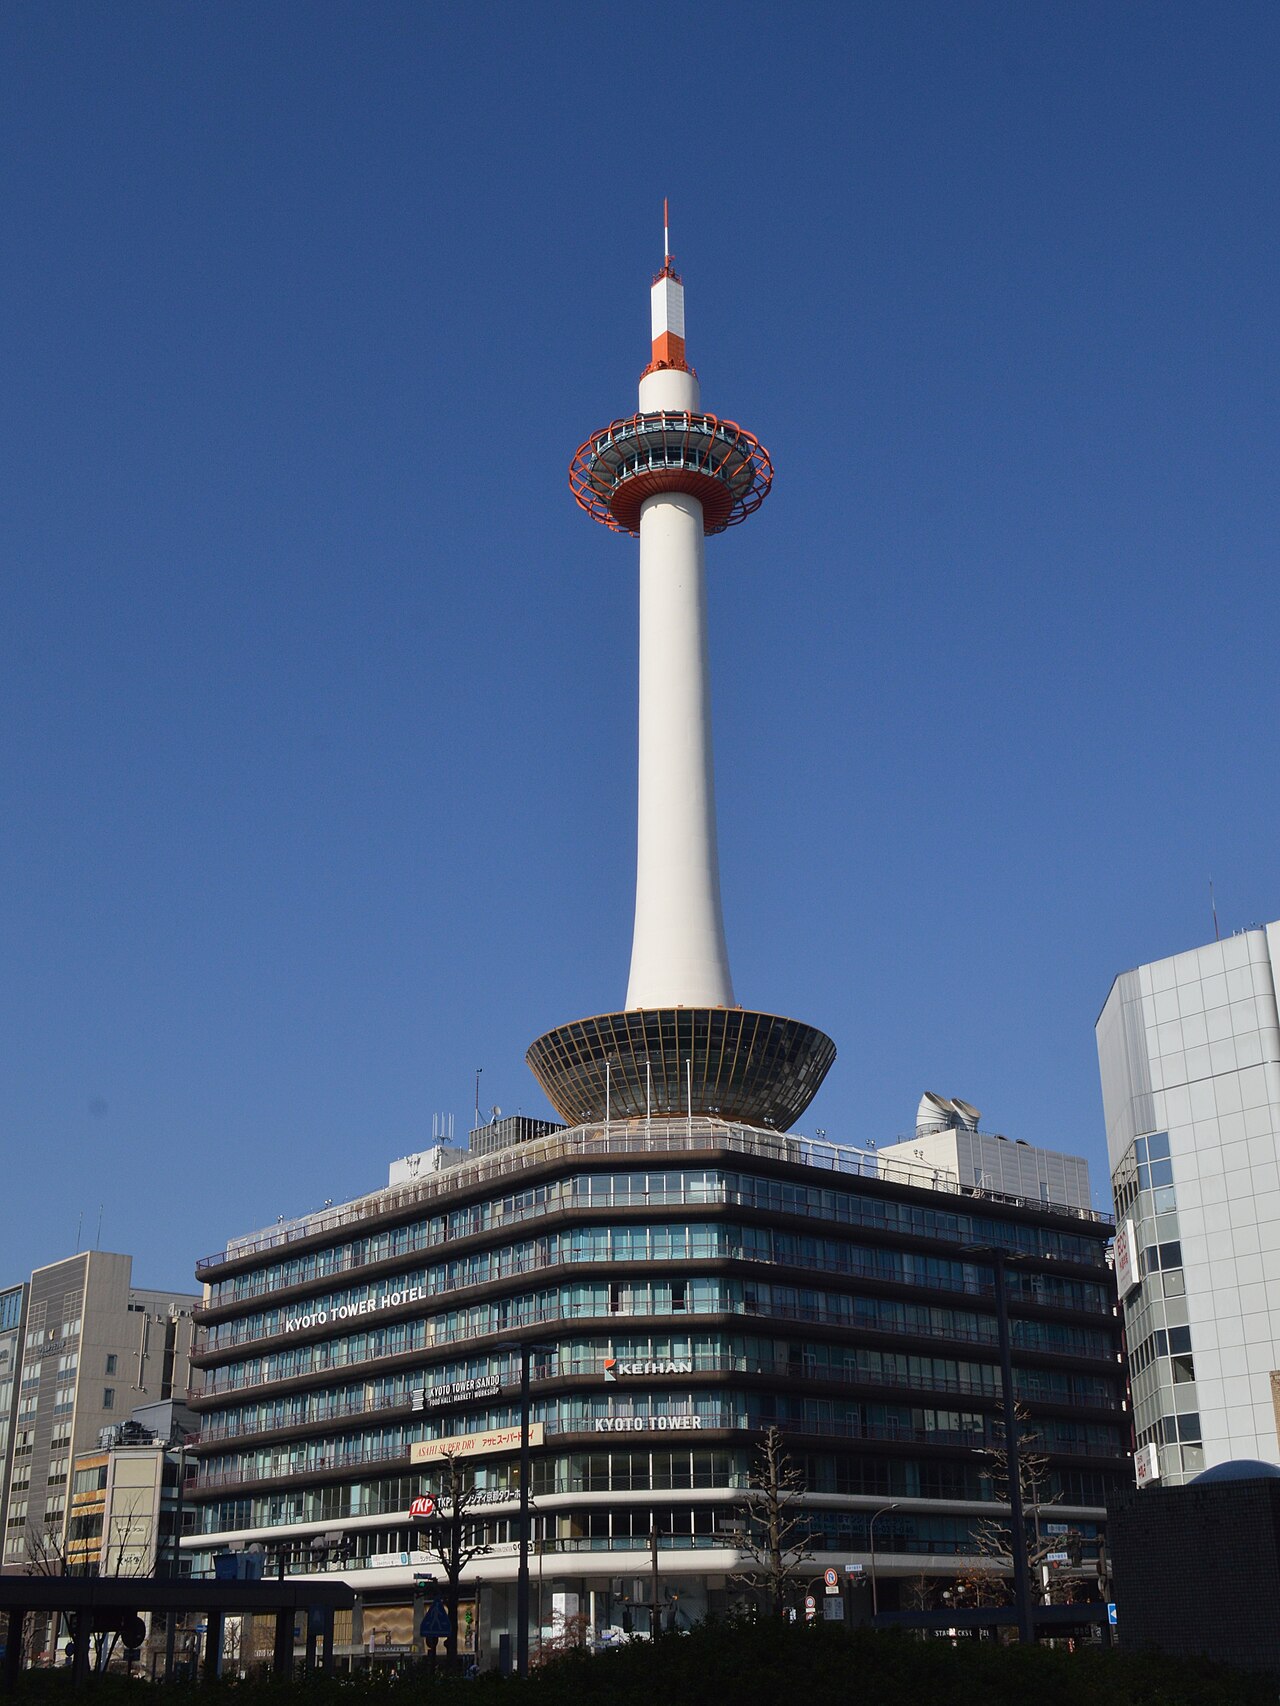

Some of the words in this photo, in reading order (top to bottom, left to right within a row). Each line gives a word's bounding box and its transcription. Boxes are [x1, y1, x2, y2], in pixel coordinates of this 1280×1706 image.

[285, 1311, 327, 1333] KYOTO
[331, 1298, 377, 1321] TOWER
[381, 1286, 427, 1308] HOTEL
[619, 1361, 692, 1375] KEIHAN
[430, 1384, 451, 1397] KYOTO
[452, 1380, 475, 1394] TOWER
[476, 1375, 500, 1389] SANDO
[429, 1398, 440, 1407] FOOD
[441, 1396, 451, 1405] HALL
[454, 1393, 471, 1402] MARKET
[474, 1387, 499, 1398] WORKSHOP
[595, 1417, 643, 1432] KYOTO
[649, 1415, 702, 1431] TOWER
[417, 1445, 437, 1458] ASAHI
[438, 1441, 460, 1453] SUPER
[462, 1438, 476, 1450] DRY
[411, 1498, 433, 1513] TKP
